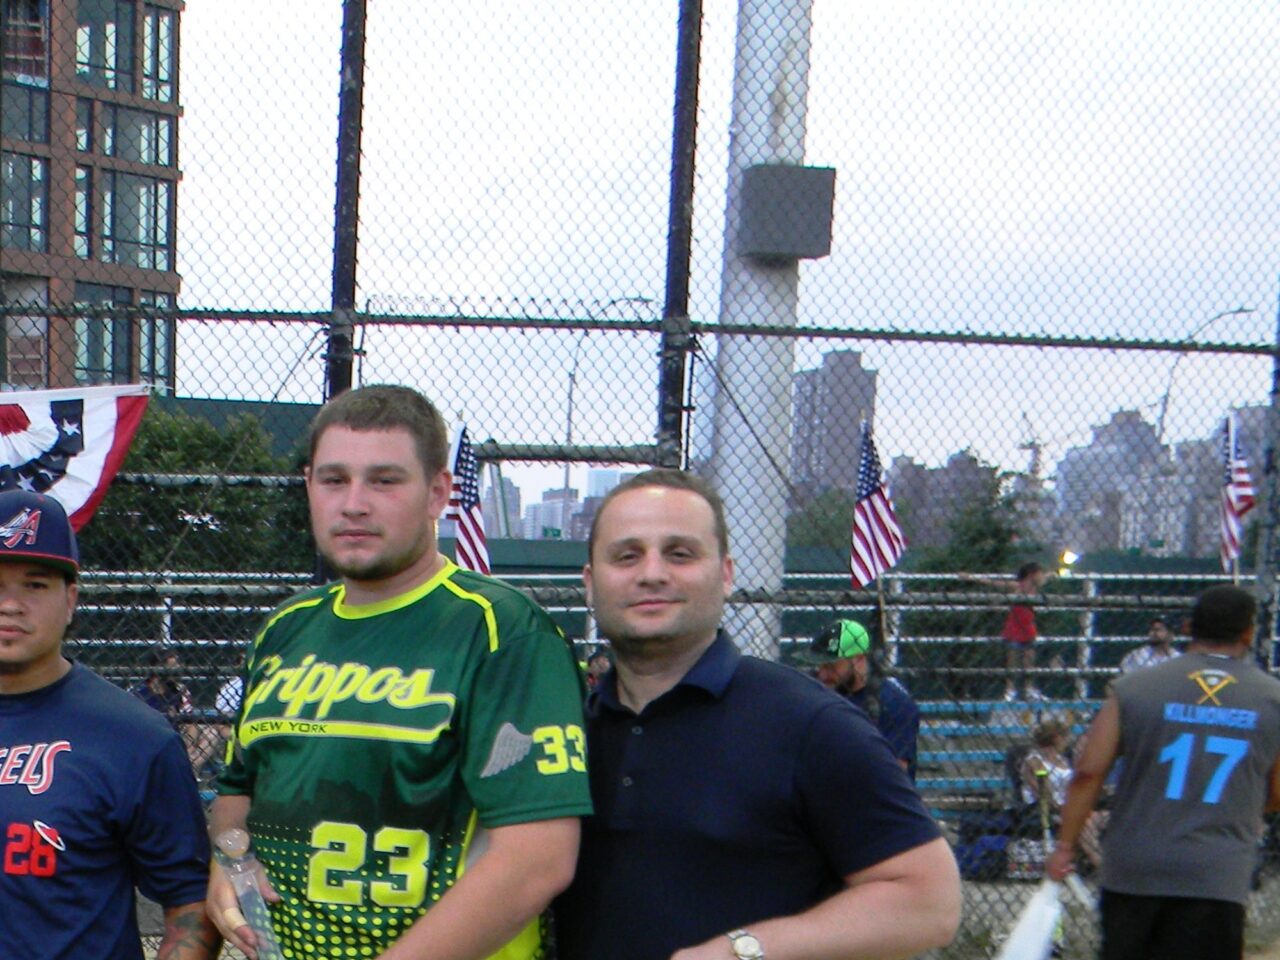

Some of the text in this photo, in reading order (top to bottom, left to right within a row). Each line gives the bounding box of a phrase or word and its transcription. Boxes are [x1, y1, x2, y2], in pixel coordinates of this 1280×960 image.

[250, 721, 328, 735] NEW YORK
[1157, 732, 1251, 804] 17
[4, 821, 59, 878] 28
[306, 819, 431, 908] 23
